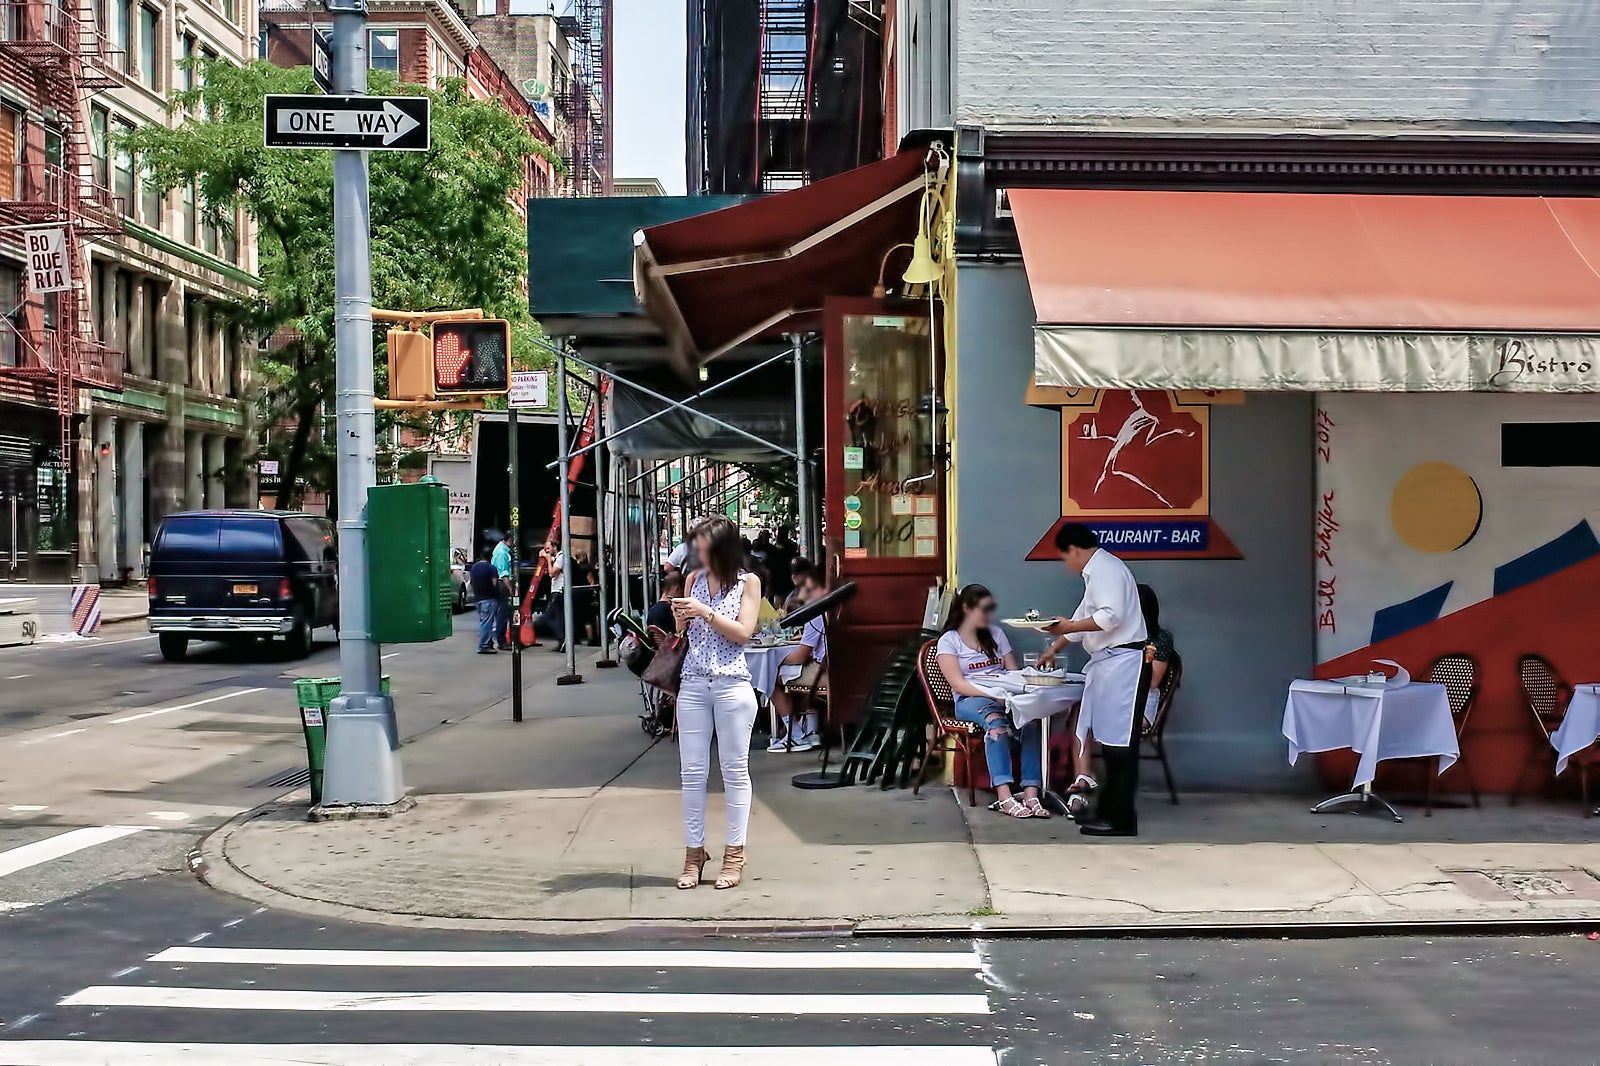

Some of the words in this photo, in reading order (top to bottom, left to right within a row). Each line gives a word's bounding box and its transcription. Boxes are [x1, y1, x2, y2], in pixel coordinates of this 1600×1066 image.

[289, 112, 334, 132] ONE
[357, 113, 403, 133] WAY
[30, 235, 49, 252] BO
[33, 252, 62, 270] QUE
[35, 270, 64, 289] RIA
[1488, 340, 1592, 387] Bistro
[1318, 408, 1335, 463] 2017
[1171, 529, 1200, 543] BAR
[1318, 576, 1336, 634] Bill
[969, 657, 1003, 670] amour
